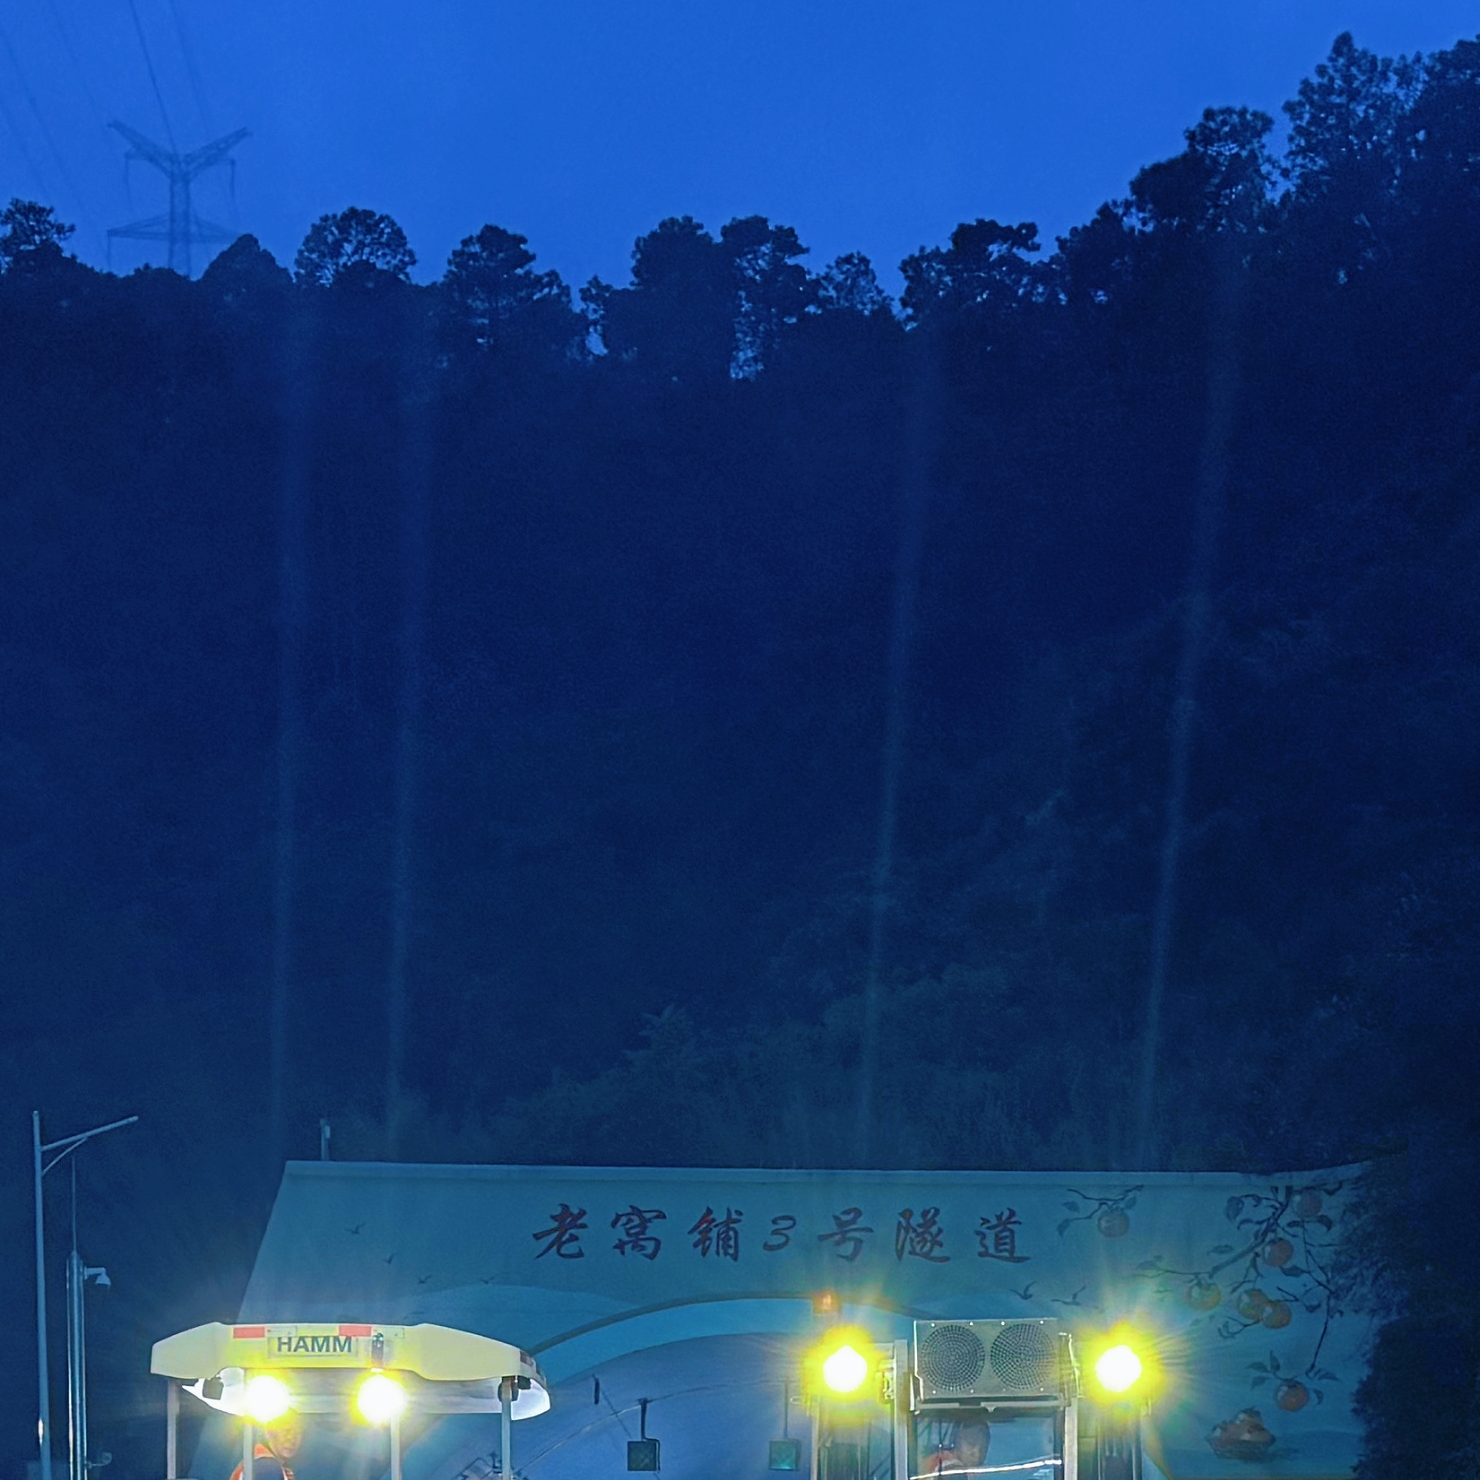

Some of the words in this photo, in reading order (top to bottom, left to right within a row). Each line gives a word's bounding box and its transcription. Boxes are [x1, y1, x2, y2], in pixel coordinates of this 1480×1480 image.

[533, 1203, 1031, 1264] 老窝铺3号隧道
[277, 1335, 352, 1353] HAMM
